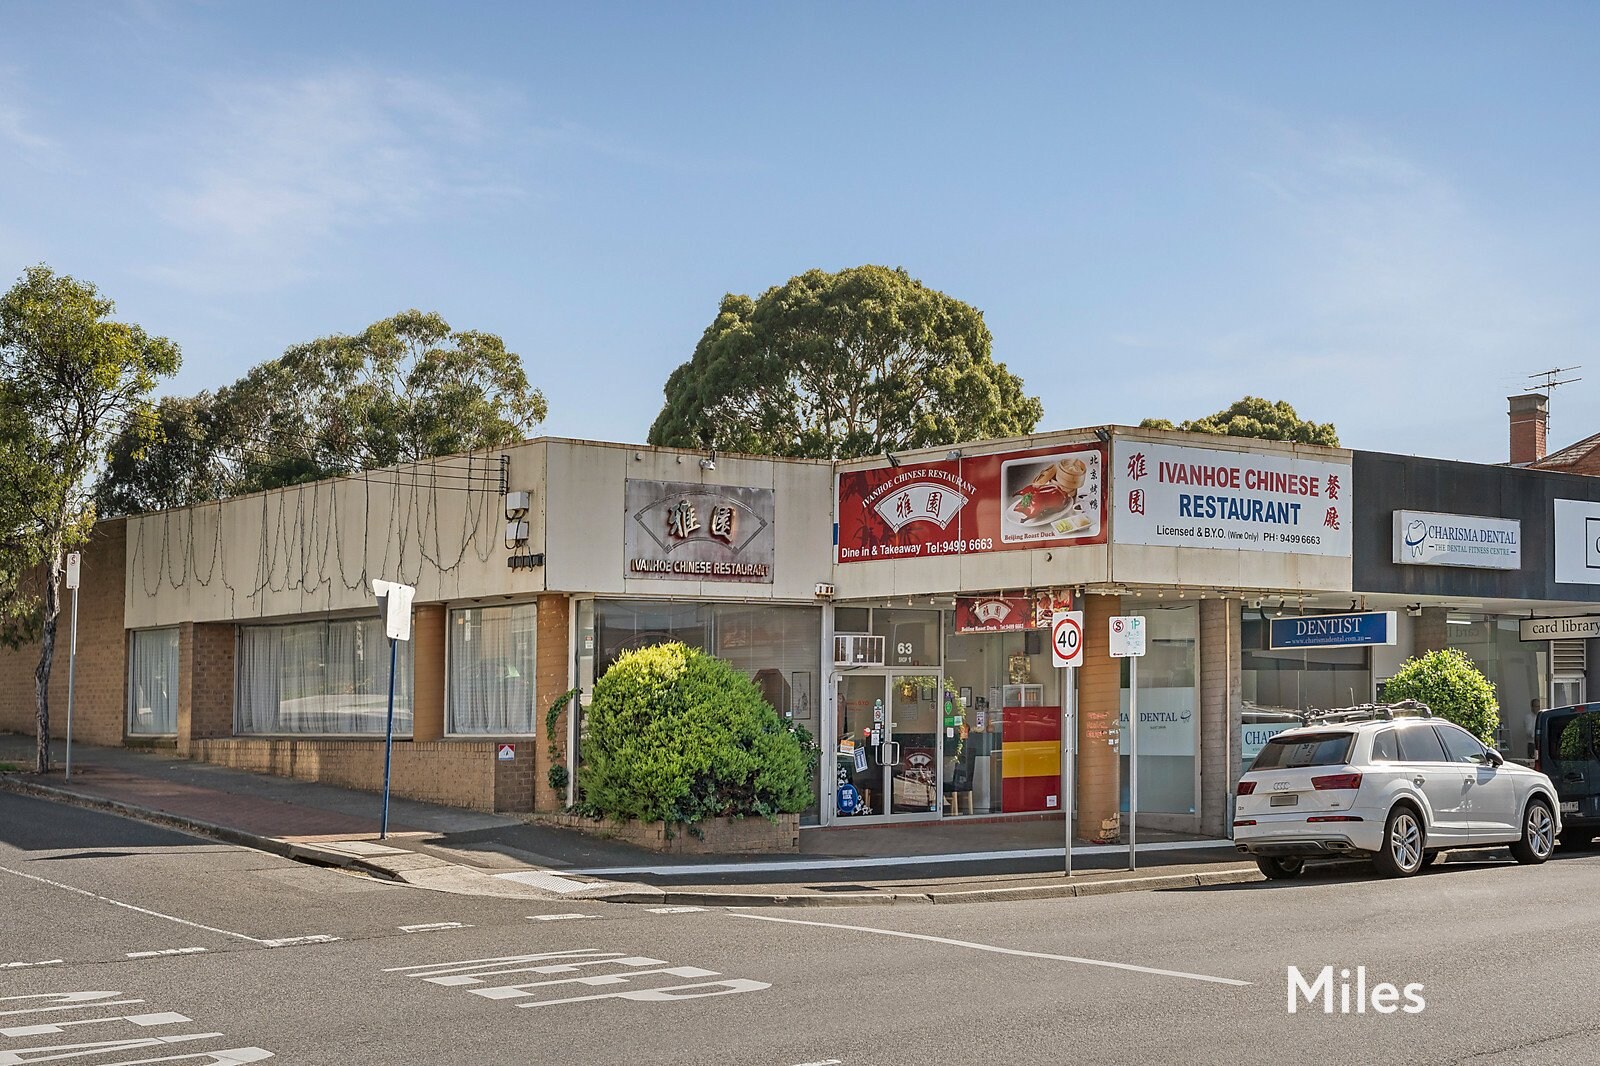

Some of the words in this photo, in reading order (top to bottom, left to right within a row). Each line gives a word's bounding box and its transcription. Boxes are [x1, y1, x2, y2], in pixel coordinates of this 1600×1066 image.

[1158, 461, 1240, 489] IVANHOE
[1245, 468, 1320, 497] CHINESE
[861, 479, 893, 508] IVANHOE
[894, 469, 926, 485] CHINESE
[928, 469, 977, 495] RESTAURANT
[1179, 494, 1301, 525] RESTAURANT
[1156, 524, 1195, 537] Licensed
[1197, 527, 1203, 537] &
[1204, 527, 1226, 538] B.Y.O.
[1228, 529, 1243, 540] (Wine
[1244, 531, 1259, 542] Only)
[1428, 525, 1478, 542] CHARISMA
[1480, 529, 1516, 544] DENTAL
[841, 548, 860, 558] Dine
[861, 546, 869, 556] in
[871, 546, 878, 556] &
[880, 543, 921, 555] Takeaway
[969, 538, 993, 550] 6663
[1447, 544, 1467, 553] DENTAL
[1468, 546, 1489, 554] FITNESS
[1490, 547, 1510, 555] CENTRE
[631, 559, 672, 572] IVANHOE
[673, 561, 711, 574] CHINESE
[713, 562, 769, 576] RESTAURANT
[1296, 618, 1362, 636] DENTIST
[1532, 620, 1558, 634] card
[1562, 619, 1600, 635] library
[897, 642, 912, 654] 63
[1057, 630, 1077, 648] 40
[1140, 712, 1178, 722] DENTAL
